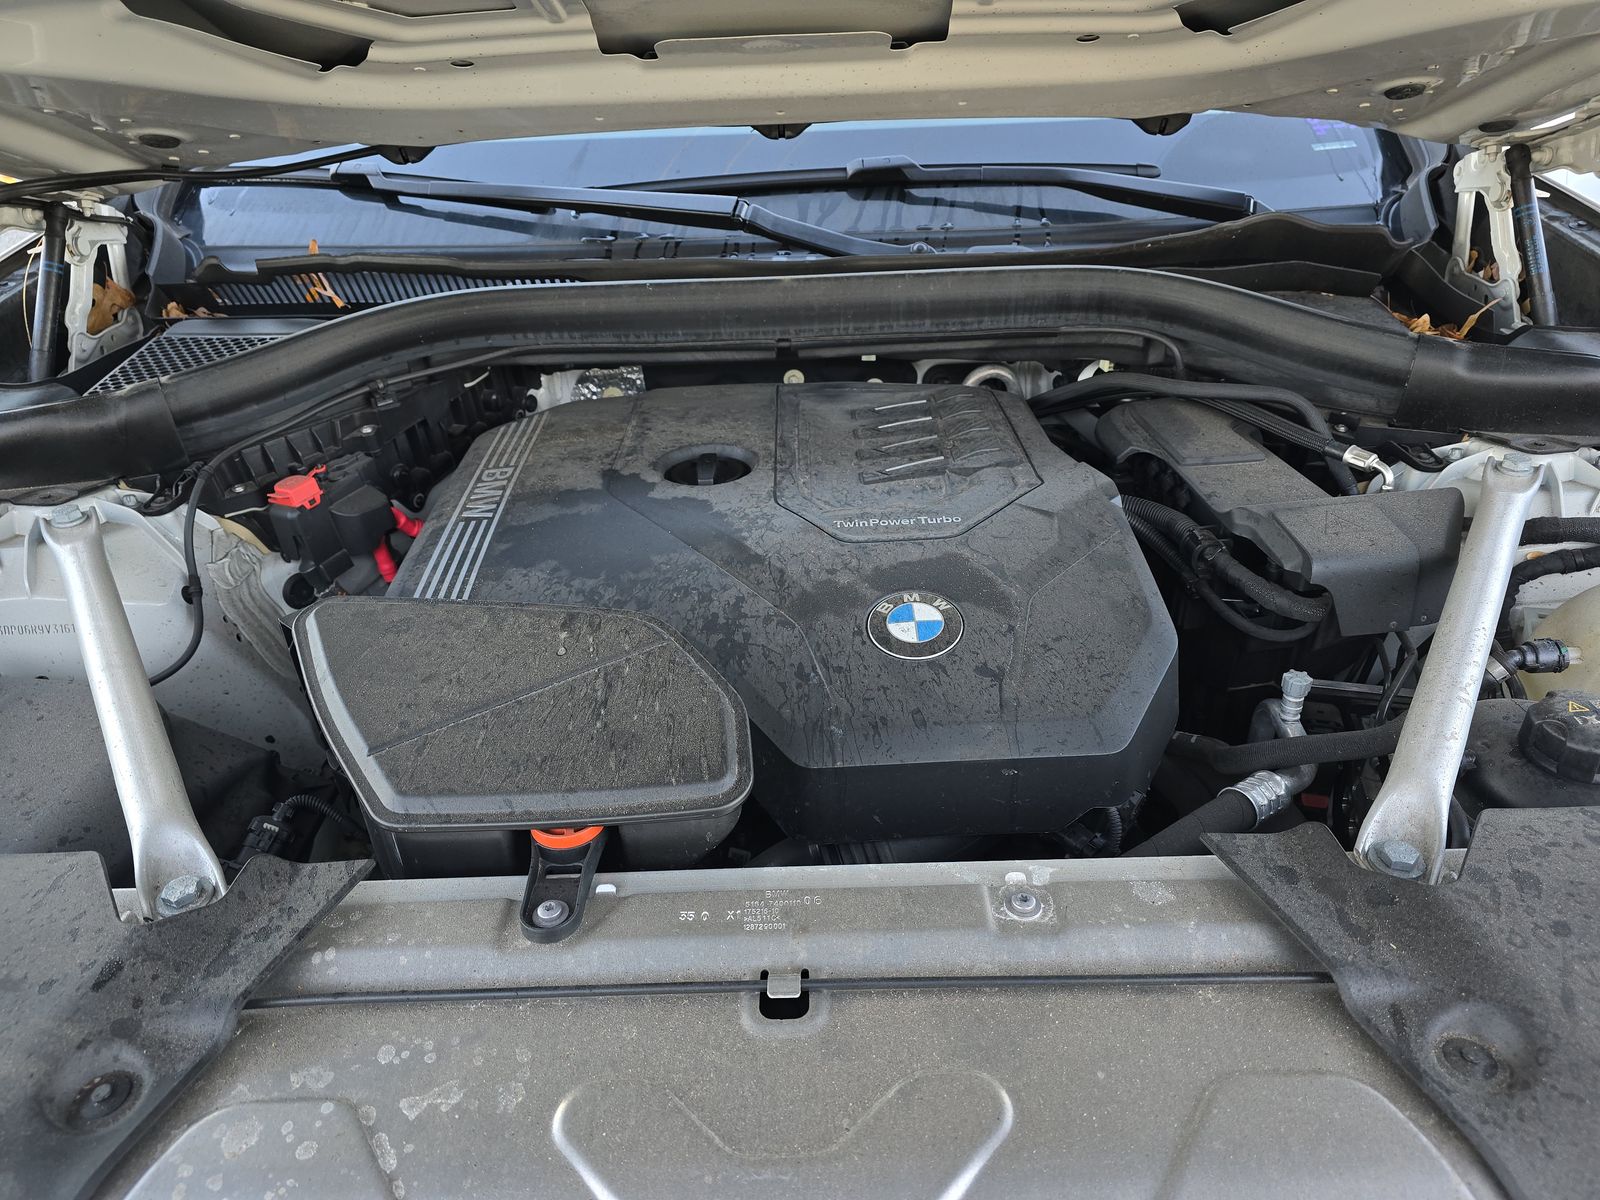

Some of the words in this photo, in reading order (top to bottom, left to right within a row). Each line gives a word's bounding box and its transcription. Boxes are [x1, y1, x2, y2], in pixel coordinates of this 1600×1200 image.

[462, 466, 515, 518] BMW
[917, 515, 962, 525] Turbo
[876, 592, 951, 614] BMW
[765, 889, 790, 899] BMW
